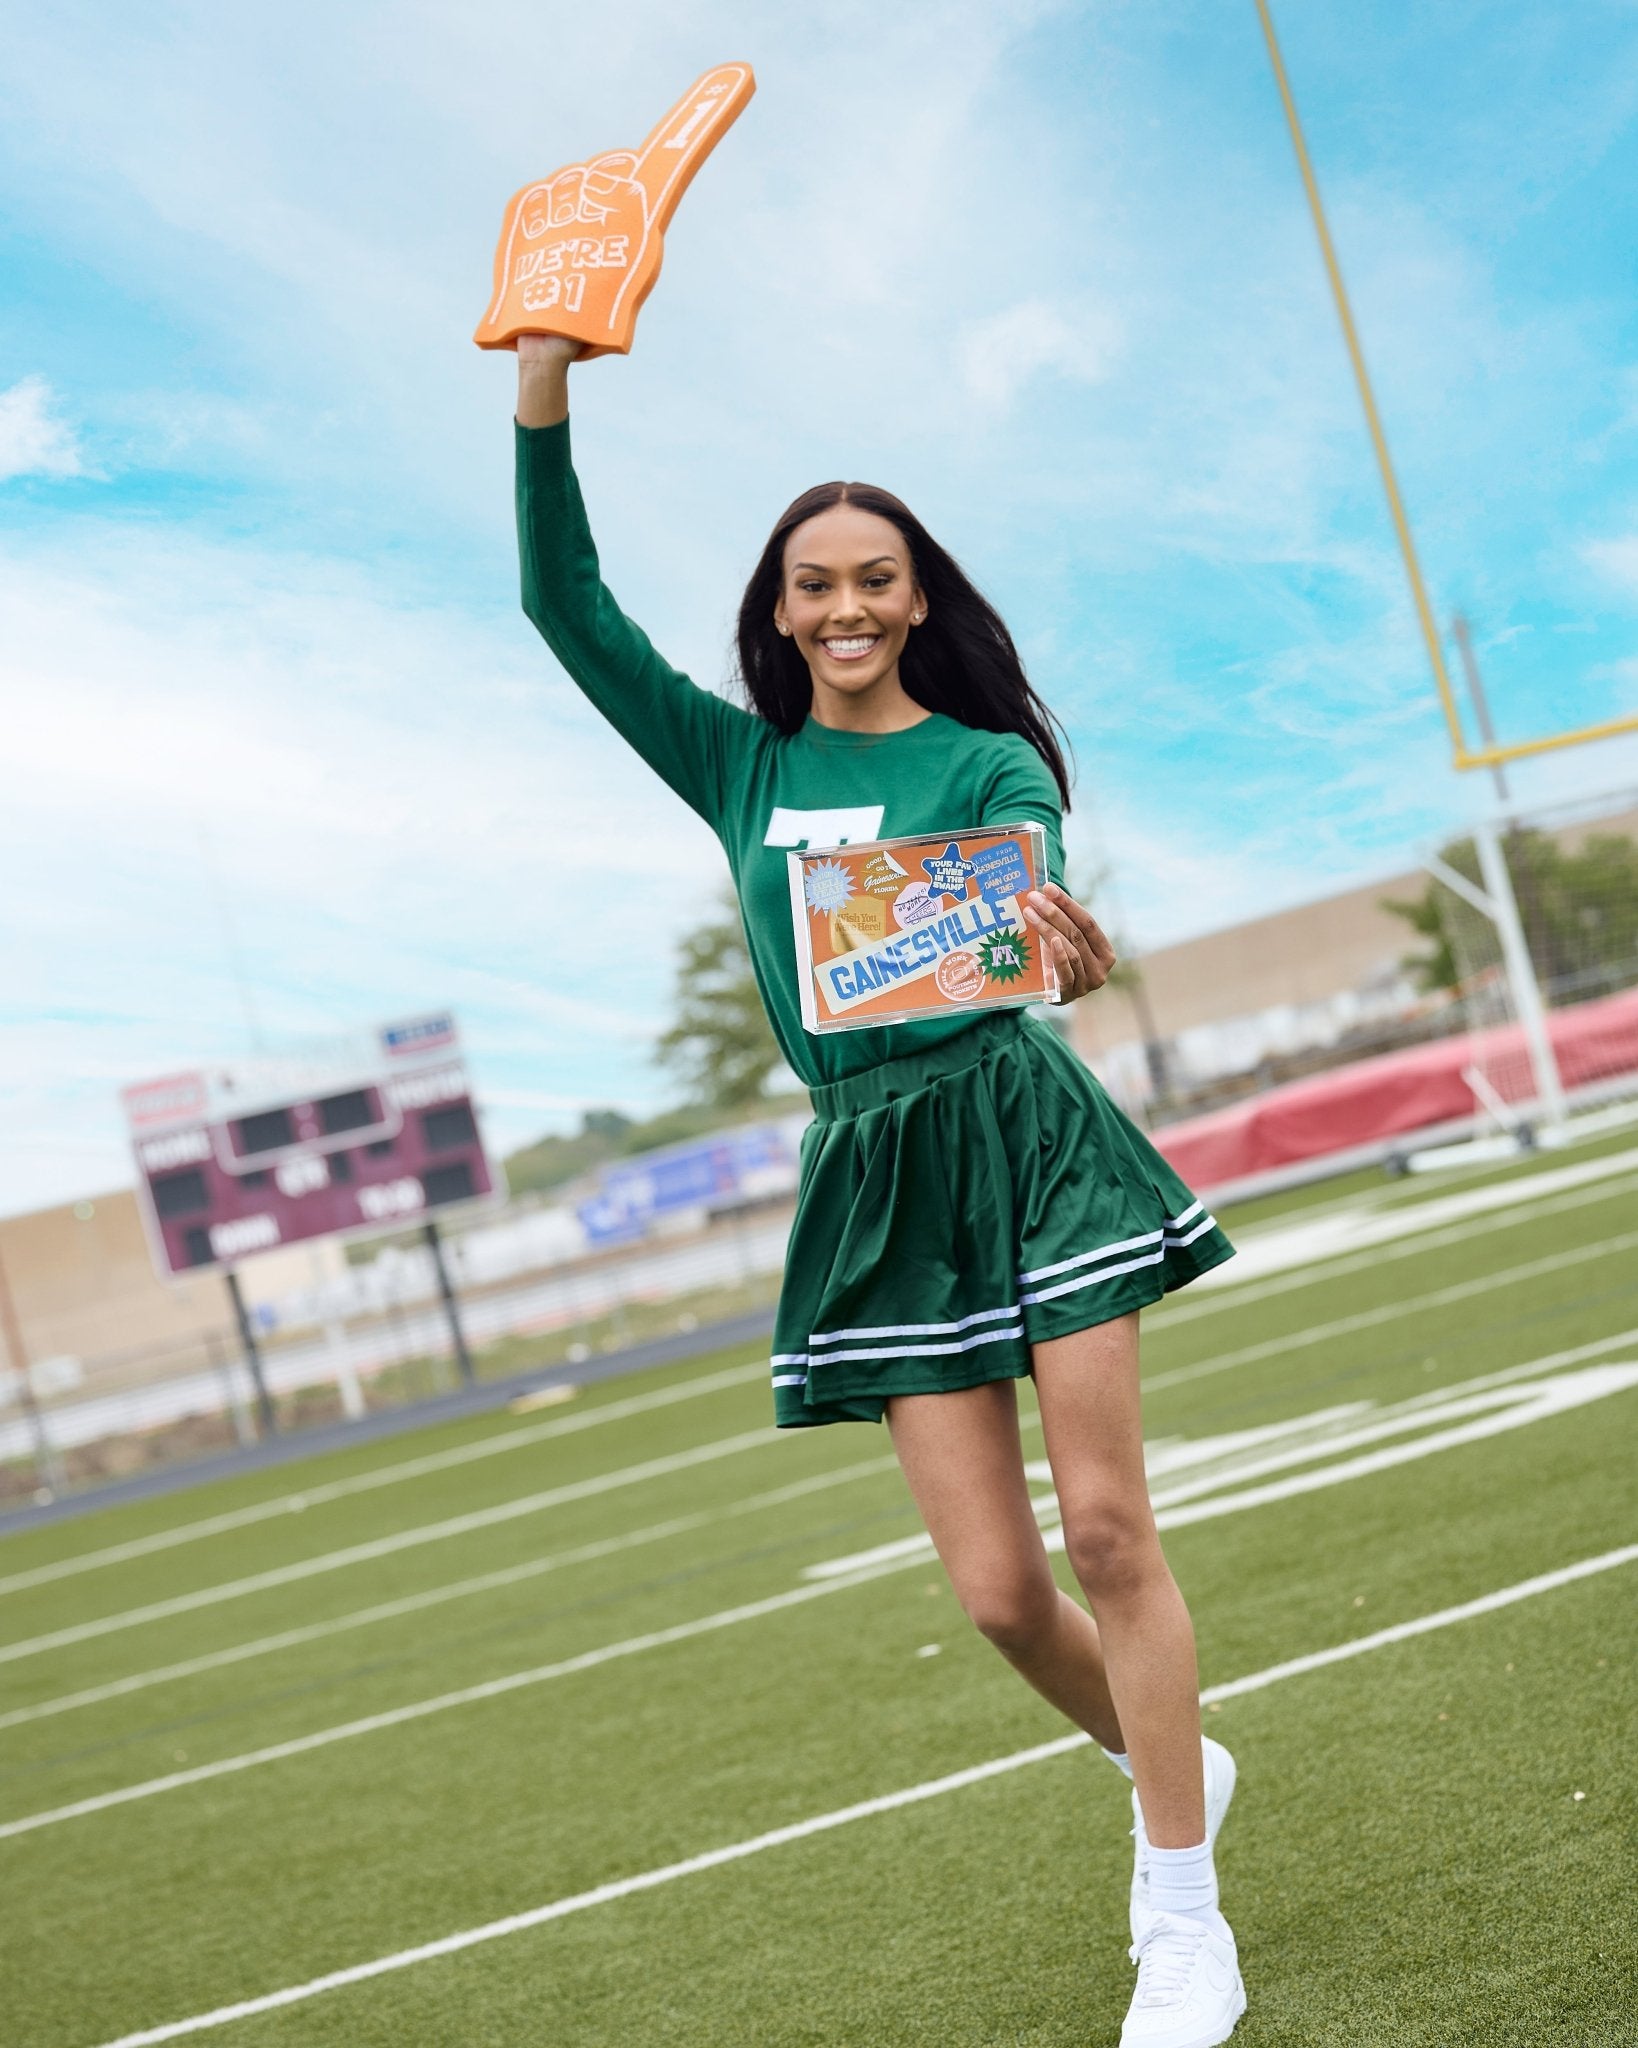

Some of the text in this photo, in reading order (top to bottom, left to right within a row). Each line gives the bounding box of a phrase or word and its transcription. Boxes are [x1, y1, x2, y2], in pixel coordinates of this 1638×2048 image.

[514, 234, 630, 286] WE'RE
[522, 273, 587, 313] #1
[975, 846, 1014, 865] LIVE FROM
[930, 860, 954, 868] YOUR
[977, 852, 1021, 875] GAINESVILLE
[937, 867, 964, 876] LIVES
[934, 874, 965, 884] IN THE
[984, 870, 1021, 890] DAMN GOOD
[874, 886, 899, 894] FLORIDA
[932, 881, 965, 891] SWAMP
[860, 913, 877, 923] You
[857, 922, 881, 931] Here!
[829, 900, 1017, 1000] GAINESVILLE
[945, 955, 968, 966] WORK
[990, 945, 1020, 968] FL
[948, 978, 979, 992] FOOTBALL
[953, 984, 978, 996] TICKETS
